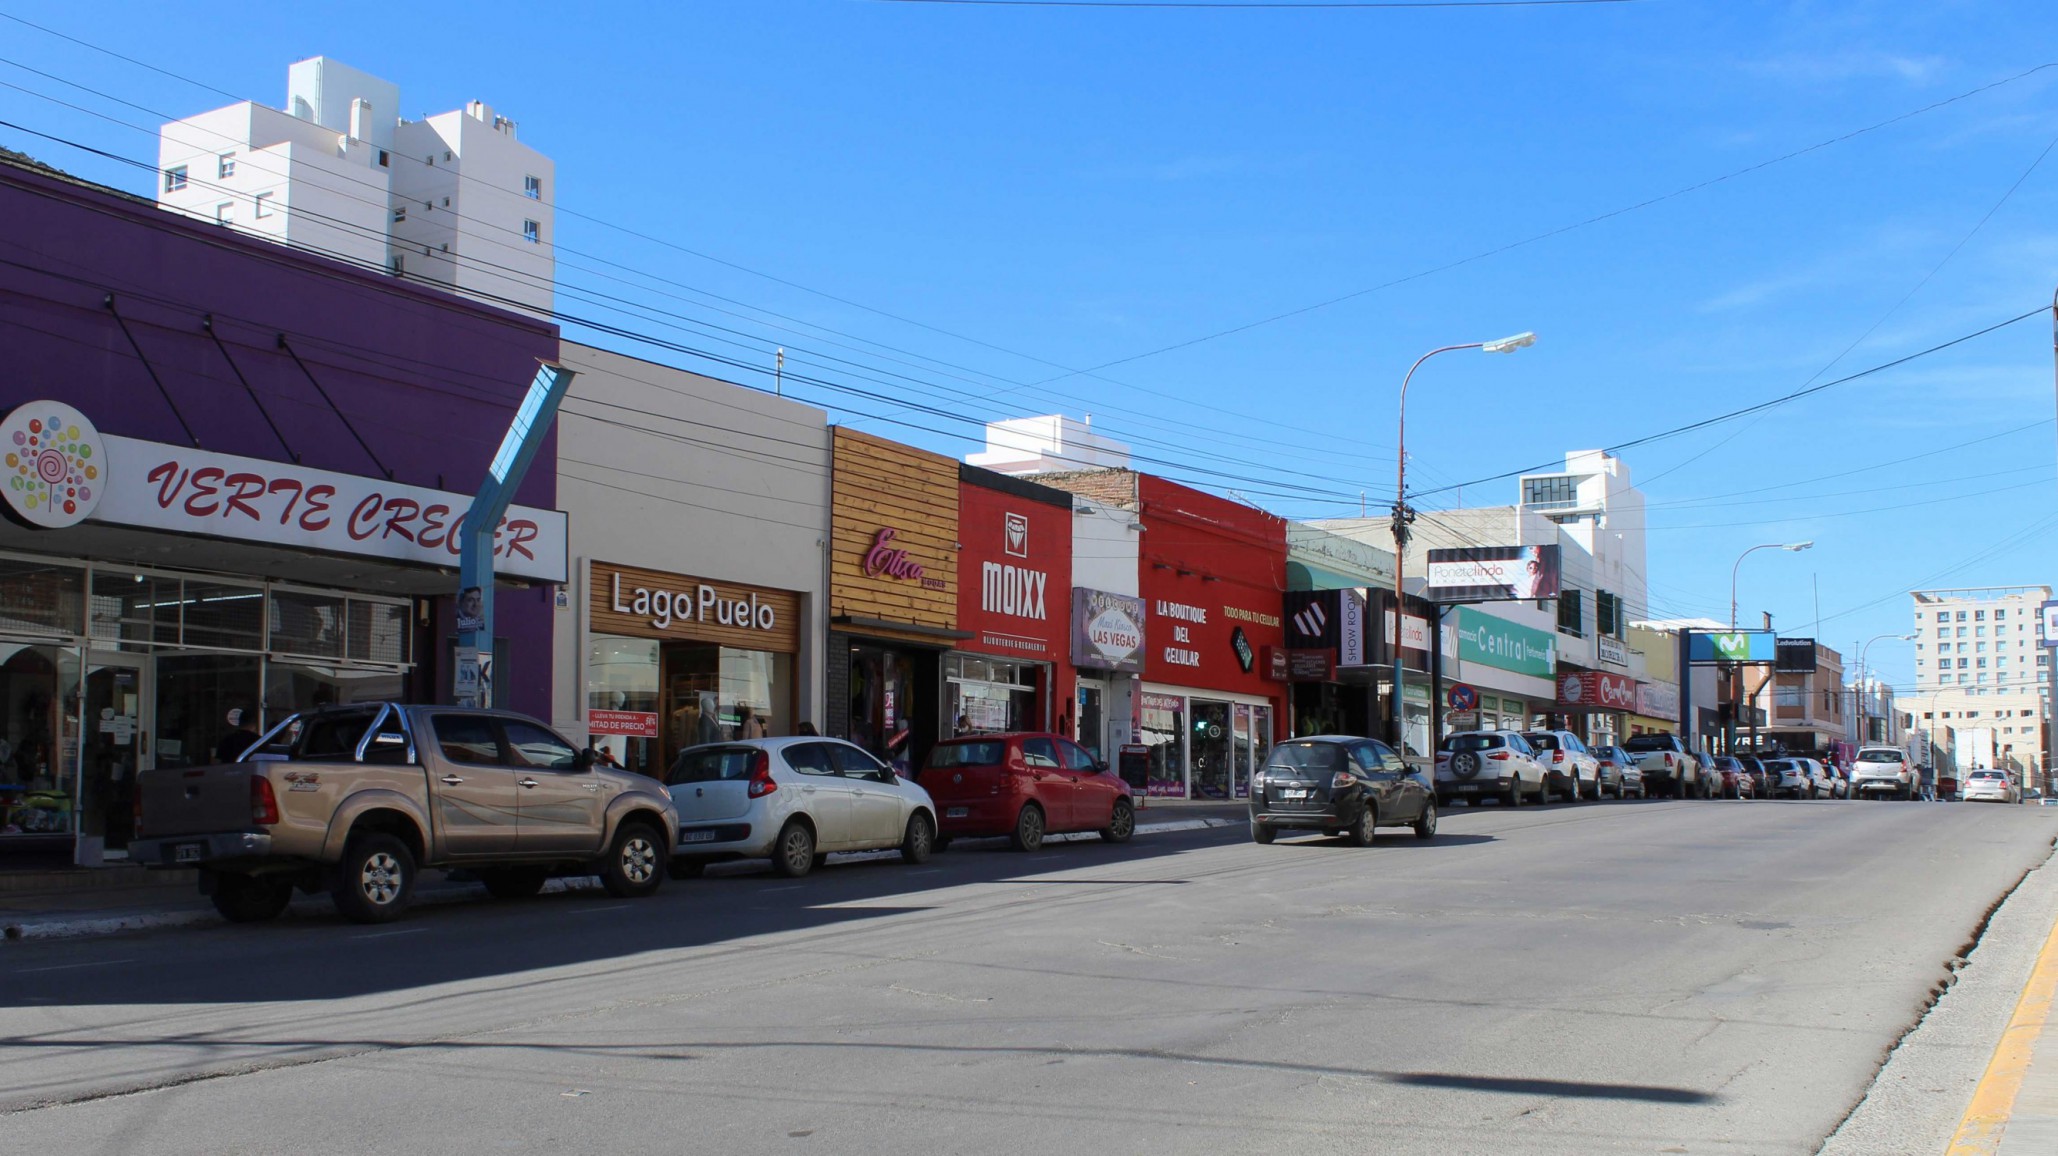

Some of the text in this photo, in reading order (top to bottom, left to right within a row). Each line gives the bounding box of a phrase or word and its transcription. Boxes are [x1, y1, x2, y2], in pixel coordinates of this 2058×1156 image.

[147, 461, 335, 531] VERTE
[864, 528, 922, 579] Elisa
[613, 572, 774, 630] Lago Puelo
[982, 561, 1047, 620] MOIXX
[1157, 600, 1207, 624] LA BOUTIQUE
[1224, 606, 1280, 627] TODO PARA TU CELULAR
[1094, 630, 1136, 648] LAS VEGAS
[1174, 626, 1190, 643] DEL
[1348, 630, 1357, 661] SHOW
[1478, 626, 1526, 661] Central
[1164, 647, 1200, 667] CELULAR
[610, 721, 620, 729] DE
[621, 722, 645, 730] PRECIO
